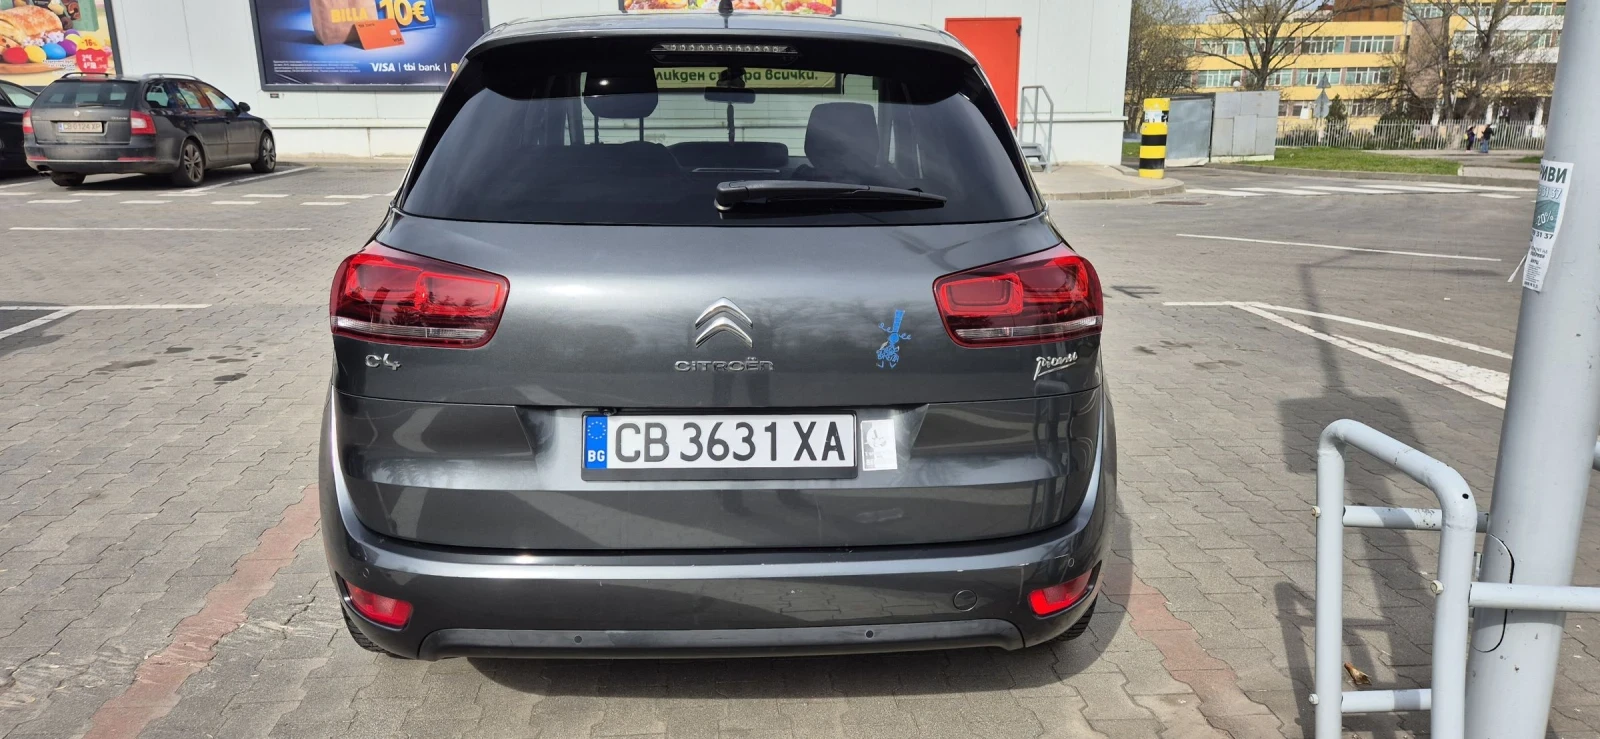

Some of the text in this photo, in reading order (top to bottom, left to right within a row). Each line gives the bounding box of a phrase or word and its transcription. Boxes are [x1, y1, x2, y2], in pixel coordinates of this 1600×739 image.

[330, 8, 368, 23] BILLA
[379, 0, 430, 26] 10€
[369, 62, 396, 72] VISA
[403, 62, 416, 72] tbi
[418, 62, 441, 72] bank
[655, 69, 705, 83] ликден
[764, 68, 818, 80] всички.
[1550, 187, 1563, 200] 37
[1544, 232, 1554, 240] 37
[365, 353, 401, 371] C4
[674, 356, 774, 372] CITROËN
[615, 421, 846, 463] CB 3631 XA
[587, 449, 606, 463] BG
